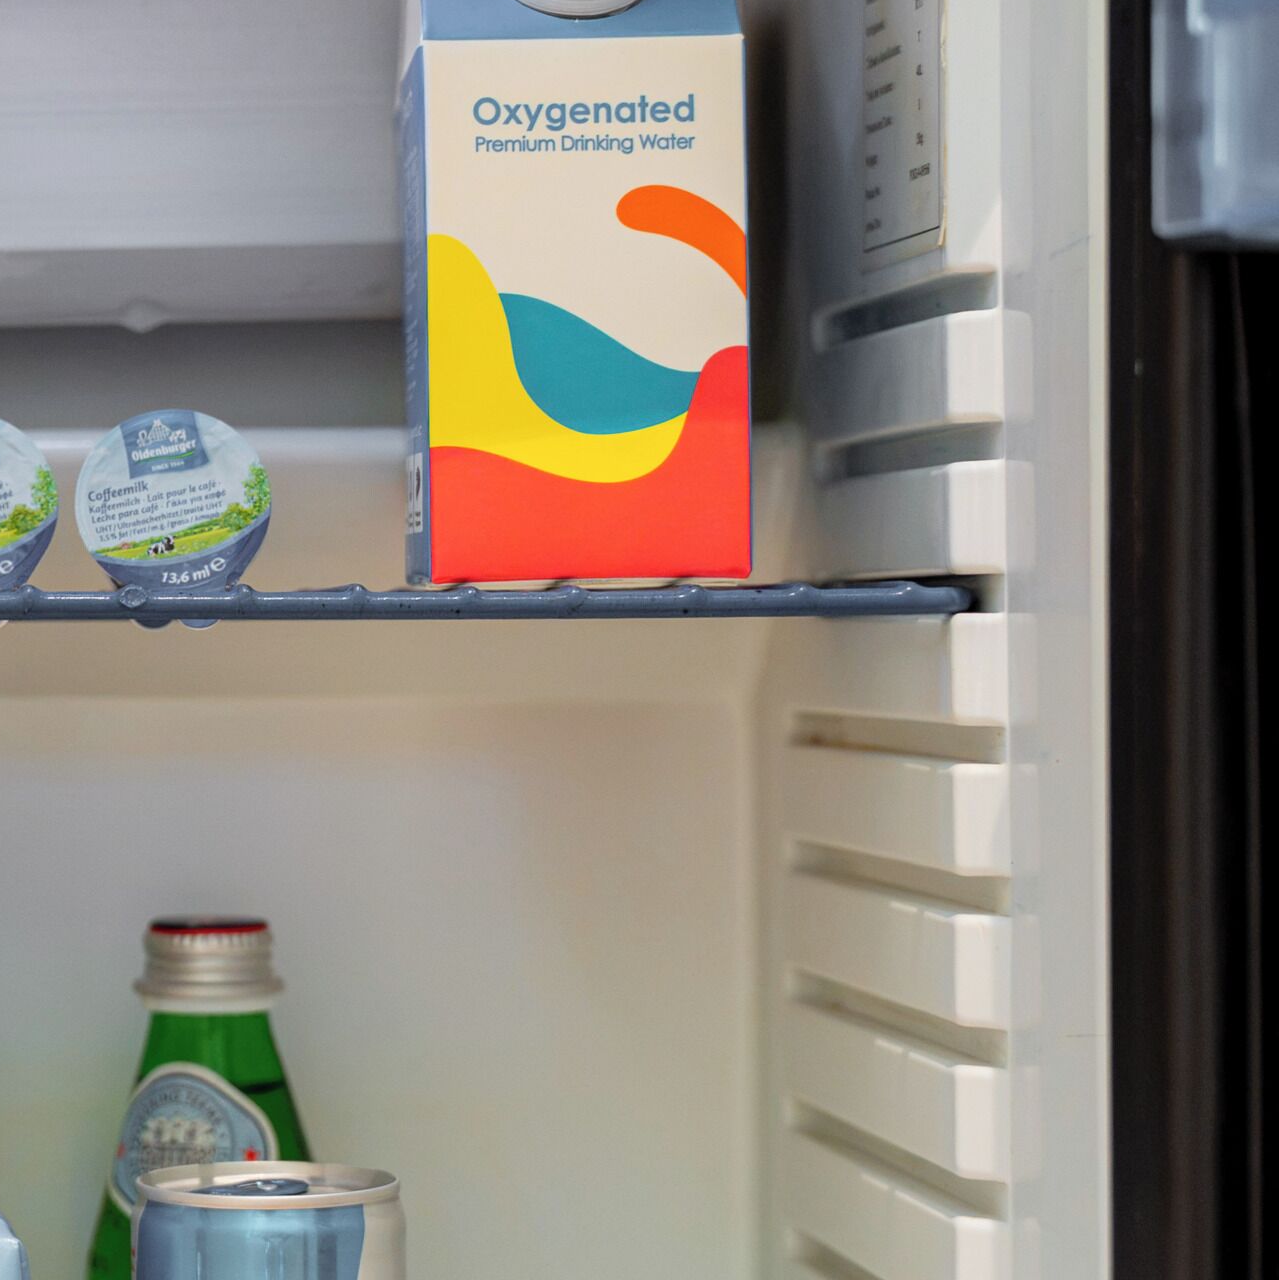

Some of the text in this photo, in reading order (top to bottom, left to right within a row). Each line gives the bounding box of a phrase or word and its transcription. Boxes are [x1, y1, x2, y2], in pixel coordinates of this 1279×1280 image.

[472, 93, 695, 132] Oxygenated
[475, 133, 695, 155] Premium Drinking Water
[132, 439, 196, 461] Oldenburger
[88, 481, 148, 504] Coffeemilk
[89, 498, 140, 514] Kaffeemilch
[166, 489, 186, 501] pour
[198, 480, 216, 493] café
[91, 514, 115, 524] Leche
[118, 509, 138, 521] para
[141, 504, 158, 516] café
[161, 572, 190, 584] 13,6
[193, 565, 210, 581] ml
